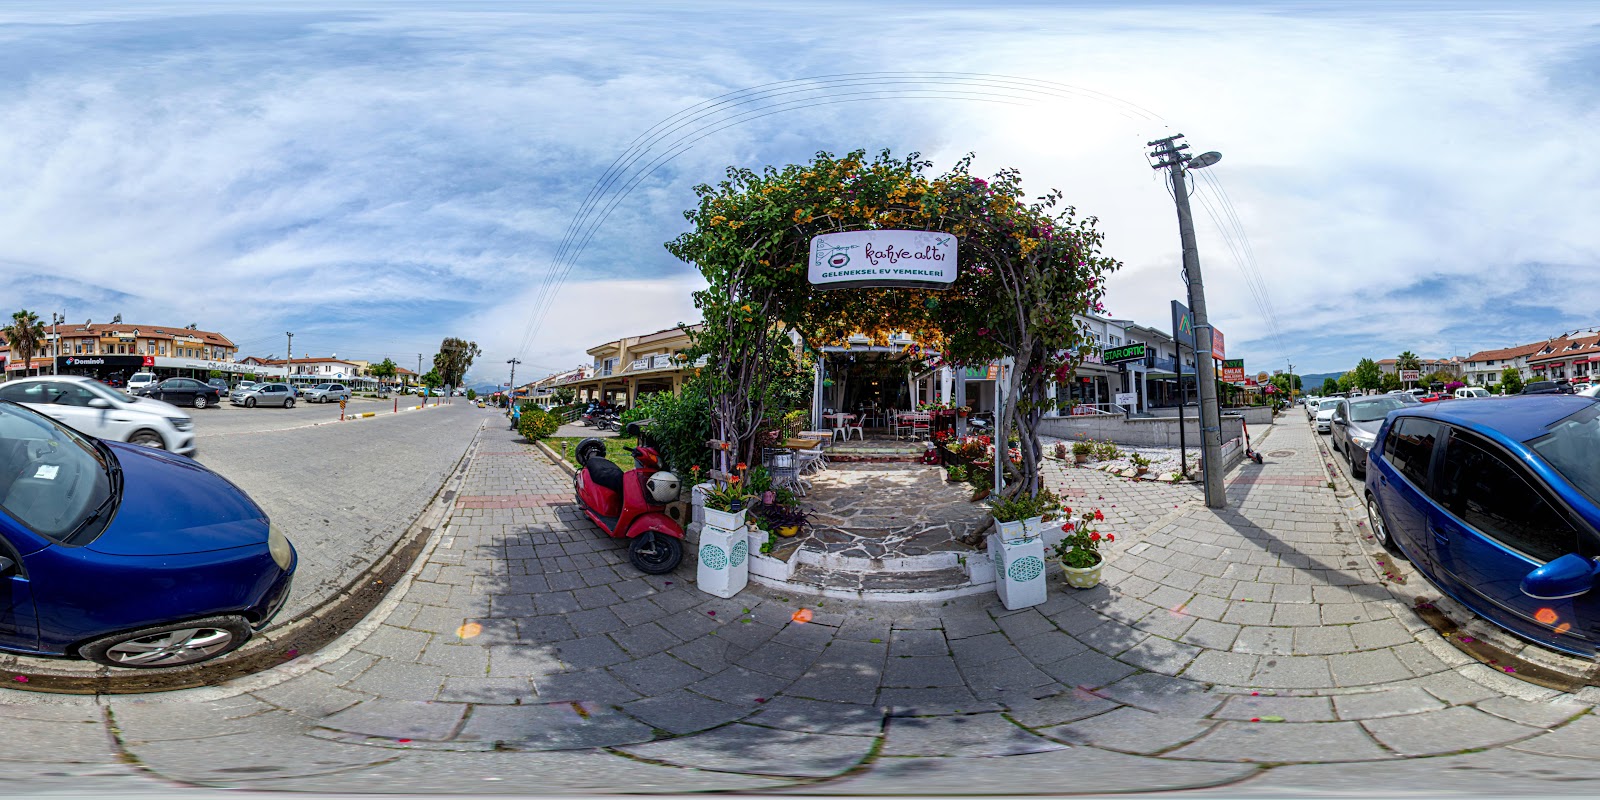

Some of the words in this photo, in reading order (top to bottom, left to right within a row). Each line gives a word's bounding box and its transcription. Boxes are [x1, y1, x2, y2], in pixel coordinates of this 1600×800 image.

[865, 242, 912, 265] kahve
[822, 269, 877, 278] GELENEKSEL
[893, 268, 943, 278] YEMEKLERİ
[1104, 349, 1122, 360] STAR
[1123, 345, 1145, 356] OPTIC
